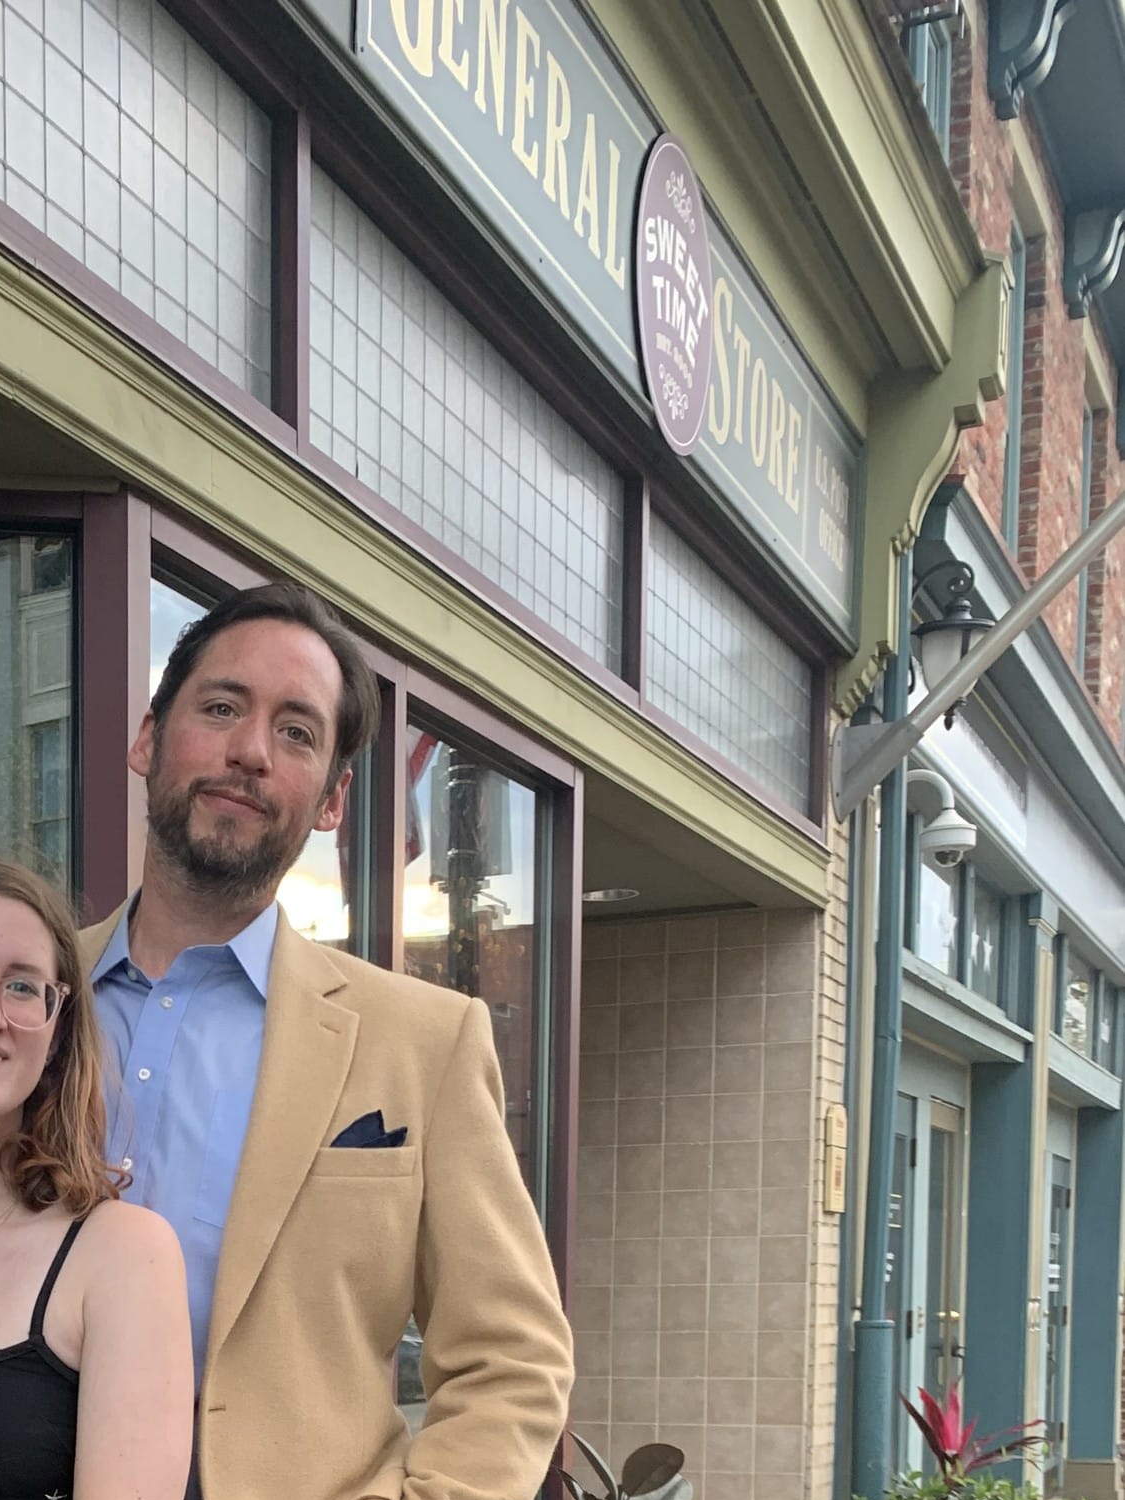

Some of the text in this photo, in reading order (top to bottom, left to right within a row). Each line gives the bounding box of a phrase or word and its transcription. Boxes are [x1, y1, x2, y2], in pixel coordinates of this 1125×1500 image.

[645, 215, 708, 328] SWEET
[652, 275, 700, 369] TIME
[708, 277, 802, 514] STORE
